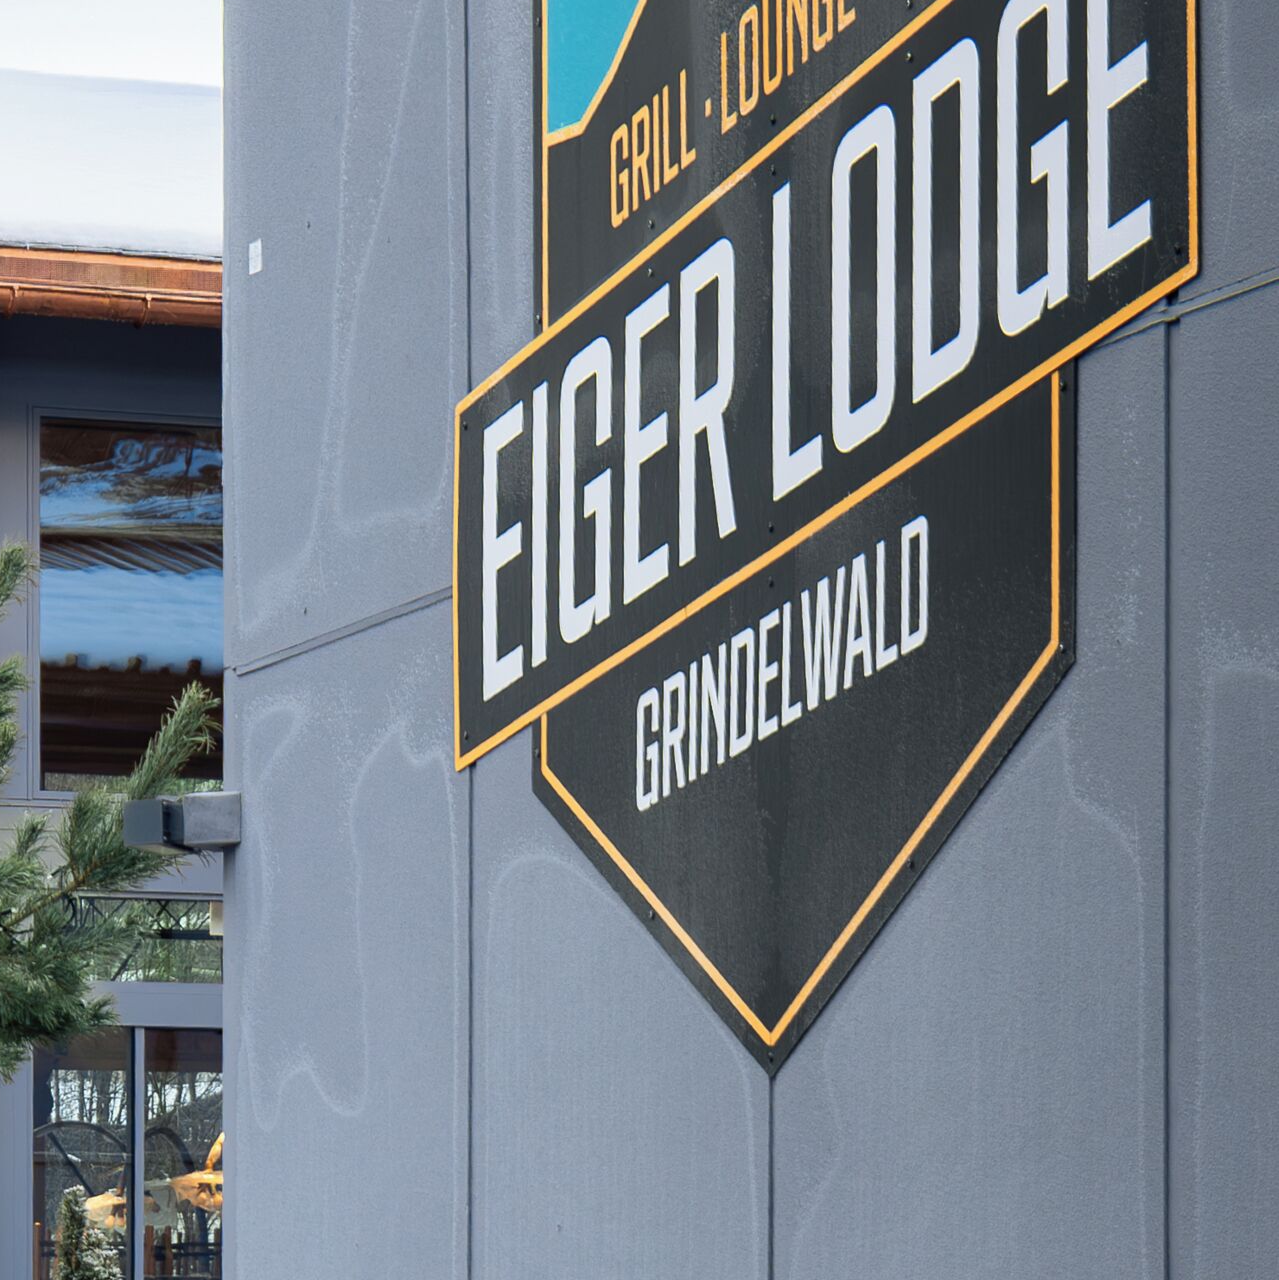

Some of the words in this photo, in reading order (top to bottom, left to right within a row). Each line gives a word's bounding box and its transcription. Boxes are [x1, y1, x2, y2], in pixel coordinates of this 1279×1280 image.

[610, 68, 697, 228] GRILL
[482, 237, 737, 702] EIGER
[635, 515, 929, 811] GRINDELWALD
